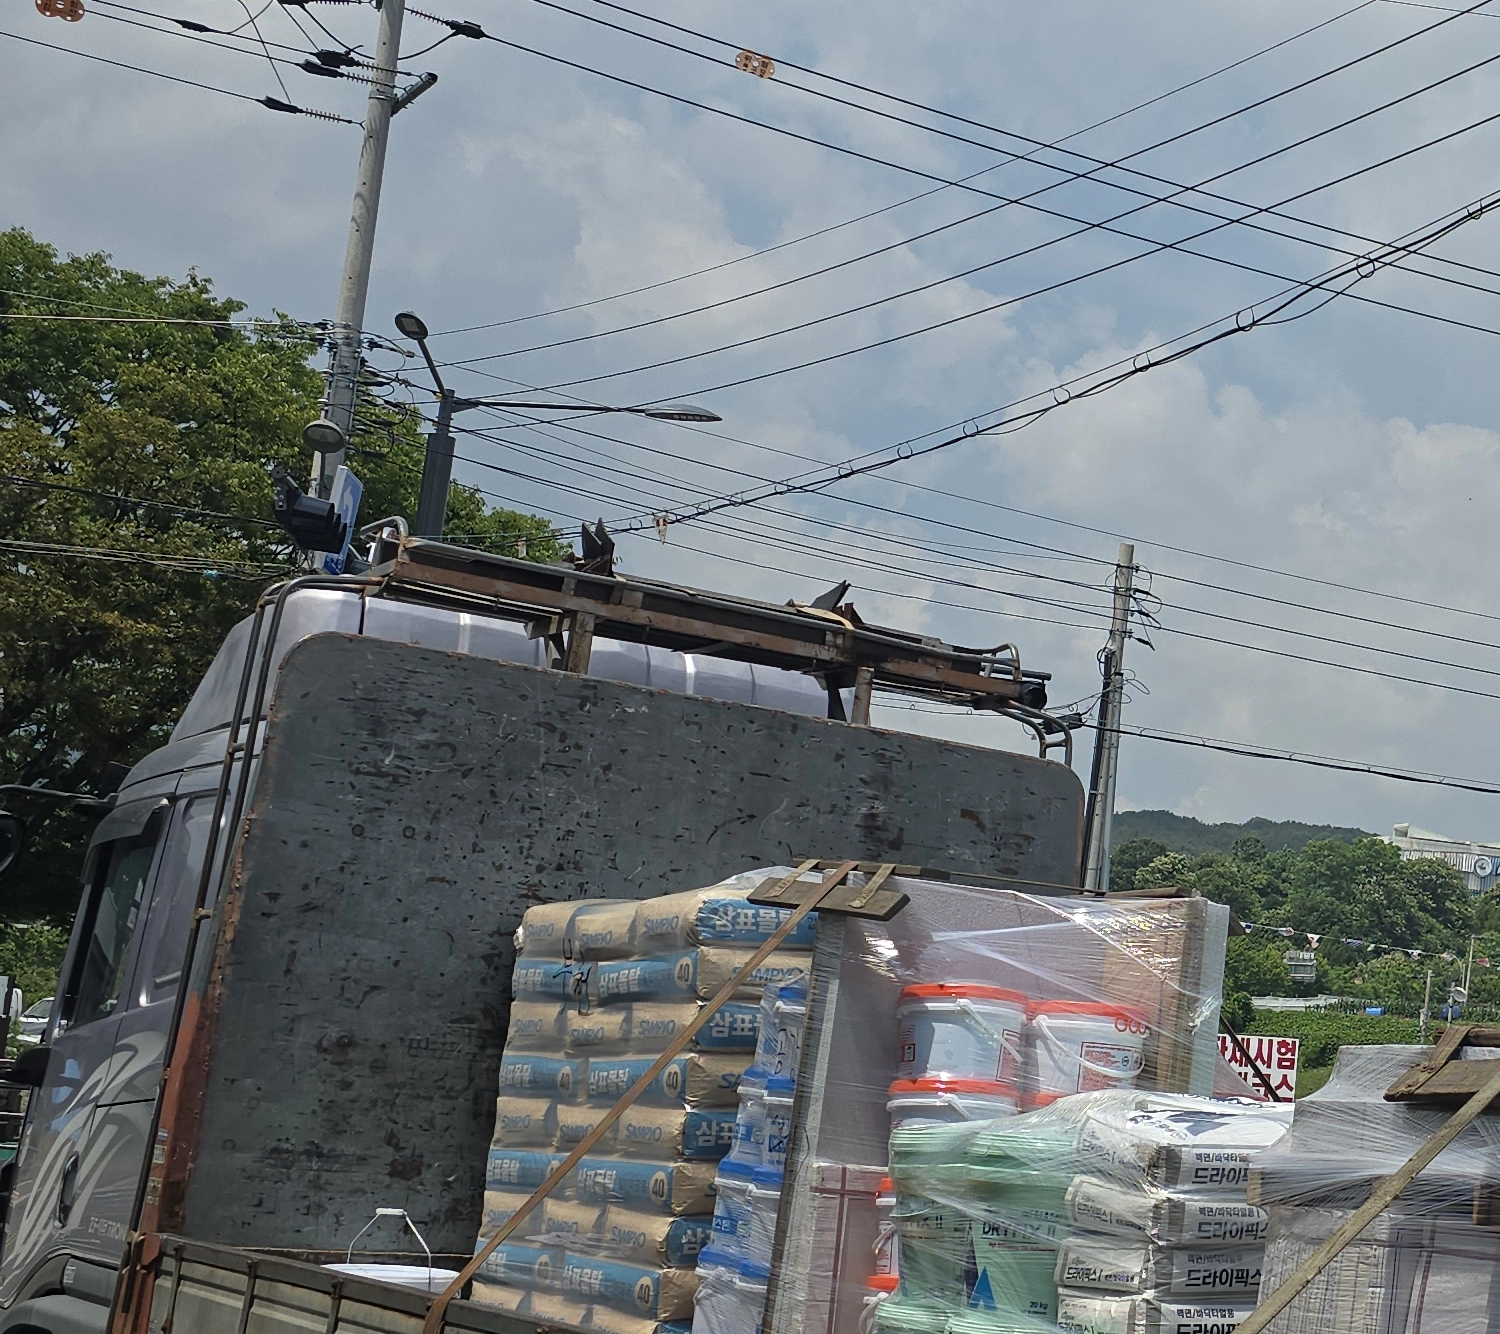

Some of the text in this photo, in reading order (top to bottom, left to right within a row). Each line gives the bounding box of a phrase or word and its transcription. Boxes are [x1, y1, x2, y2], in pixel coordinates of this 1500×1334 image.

[600, 966, 641, 996] 삼표몰탈
[677, 965, 691, 984] 40
[558, 1070, 571, 1087] 40
[589, 1068, 630, 1094] 삼표몰탈
[665, 1069, 679, 1087] 40
[651, 1176, 665, 1198] 40
[1184, 1268, 1261, 1288] 드라이픽스
[638, 1282, 651, 1304] 40
